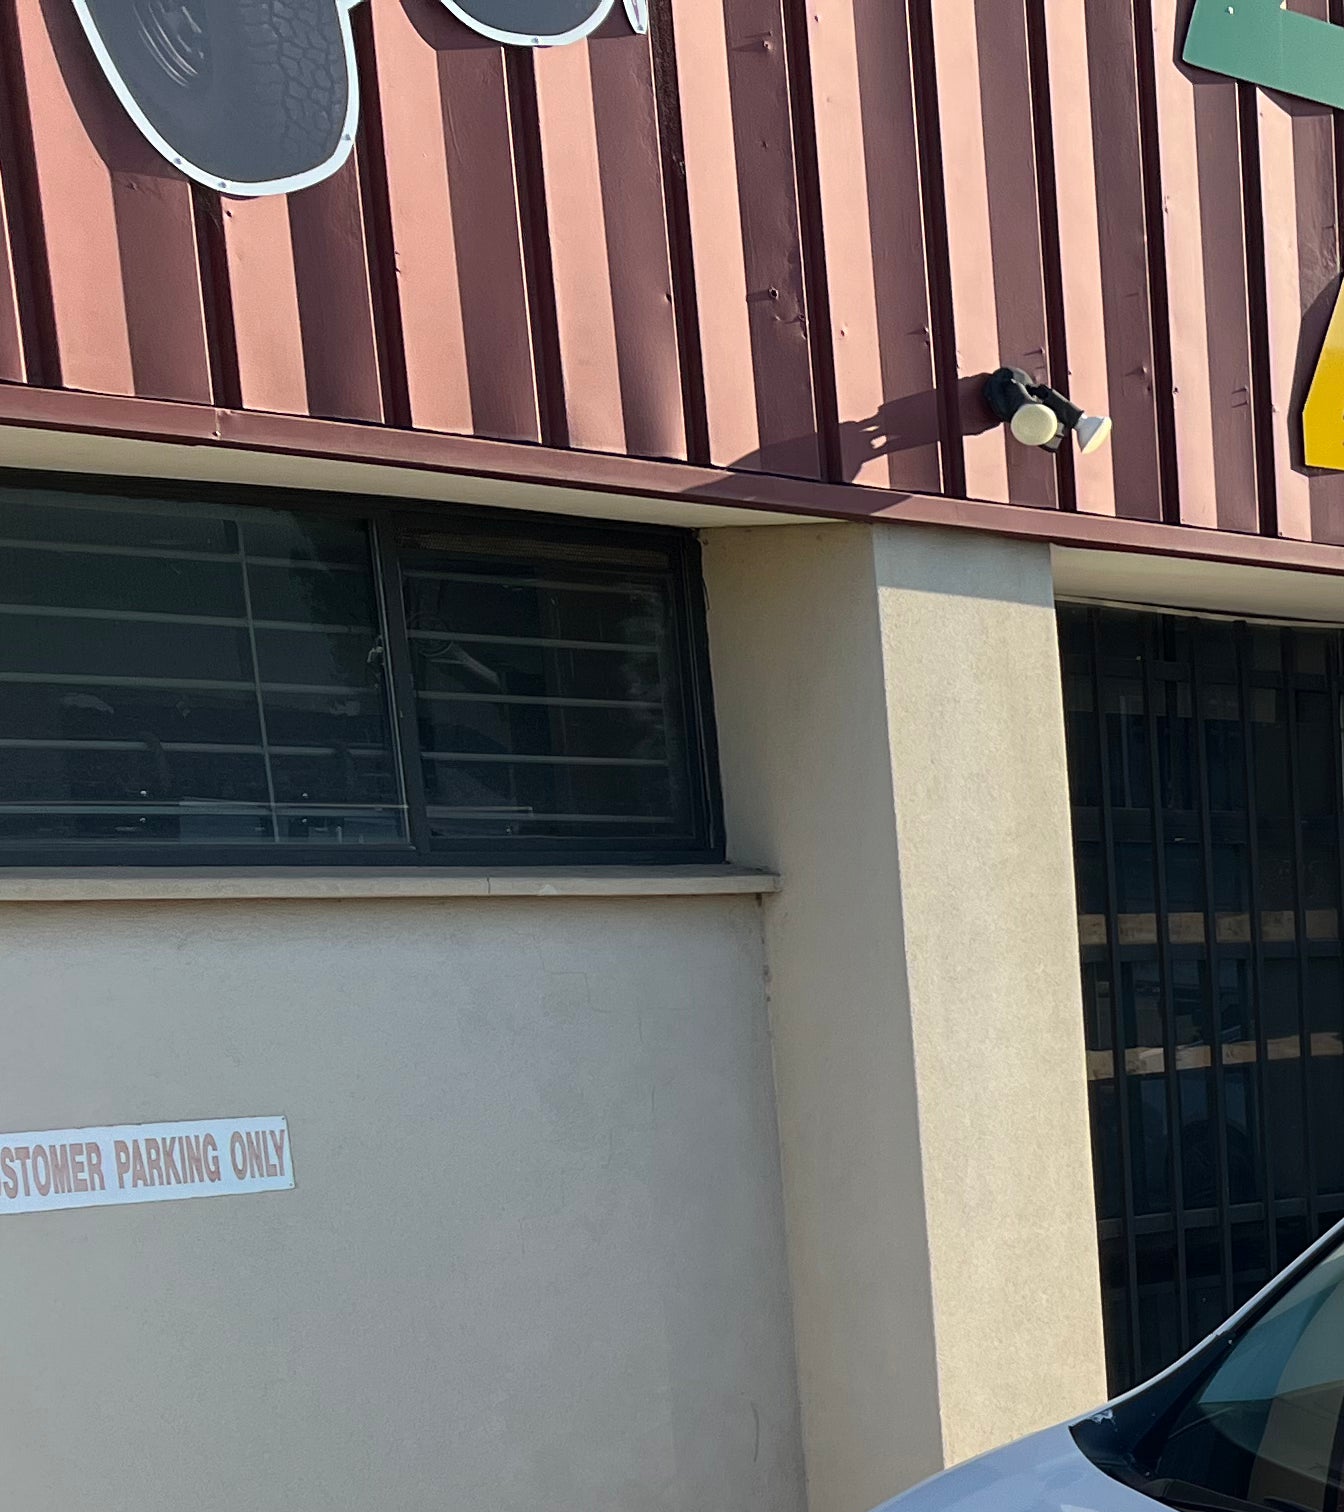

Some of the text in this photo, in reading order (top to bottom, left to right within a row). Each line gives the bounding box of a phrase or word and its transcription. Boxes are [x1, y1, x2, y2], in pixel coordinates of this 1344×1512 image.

[0, 1129, 286, 1199] STOMER PARKING ONLY
